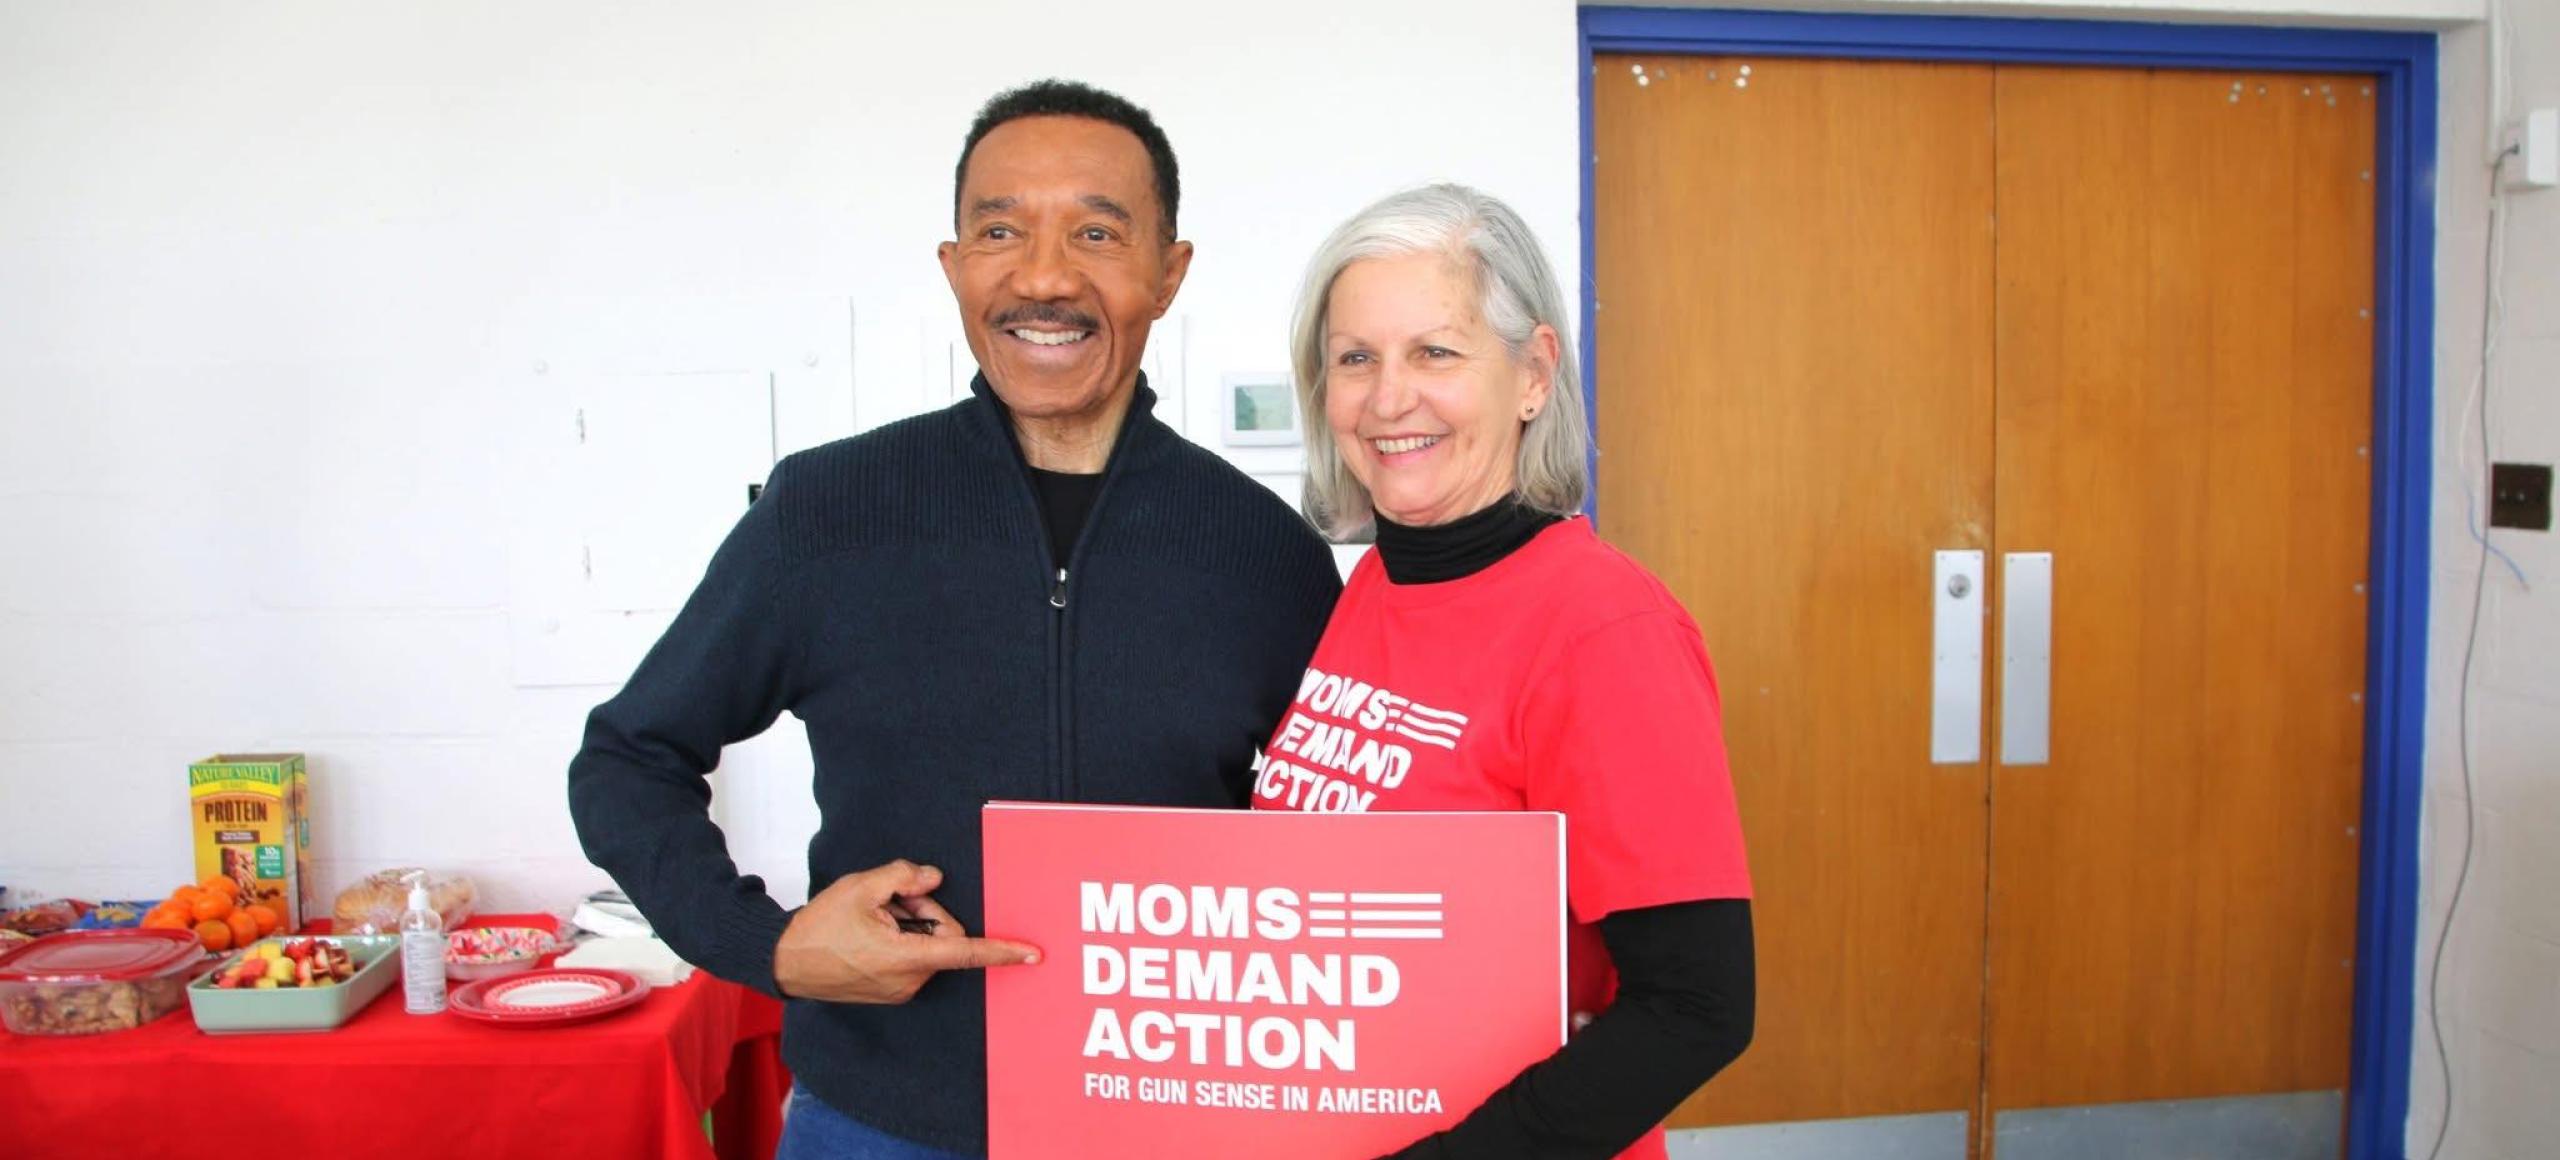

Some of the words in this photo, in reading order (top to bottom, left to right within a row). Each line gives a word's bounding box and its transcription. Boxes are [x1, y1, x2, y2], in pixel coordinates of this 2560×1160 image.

[1273, 711, 1412, 789] EMAND
[204, 799, 267, 823] PROTEIN
[1080, 881, 1302, 940] MOMS
[1082, 944, 1400, 1007] DEMAND
[1083, 1008, 1355, 1071] ACTION
[1085, 1073, 1130, 1100] FOR
[1139, 1078, 1187, 1104] GUN
[1195, 1080, 1275, 1110] SENSE
[1283, 1086, 1308, 1111] IN
[1317, 1087, 1443, 1114] AMERICA
